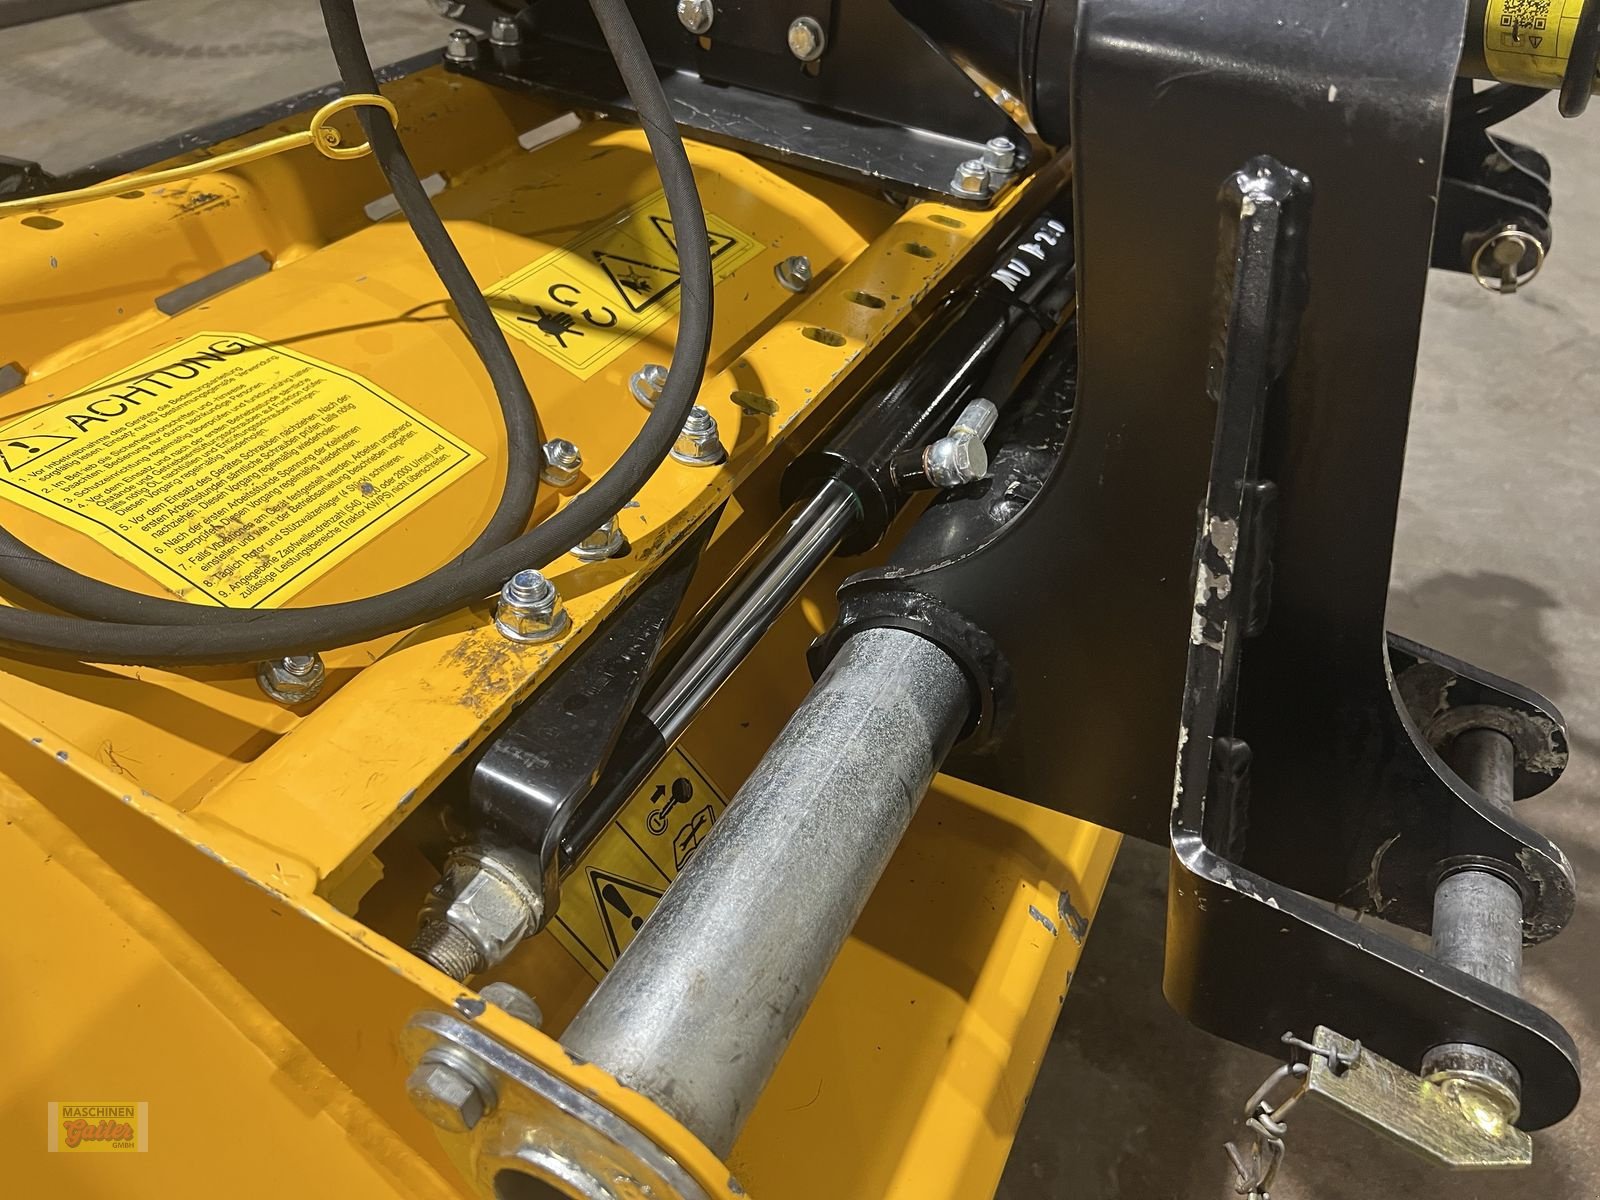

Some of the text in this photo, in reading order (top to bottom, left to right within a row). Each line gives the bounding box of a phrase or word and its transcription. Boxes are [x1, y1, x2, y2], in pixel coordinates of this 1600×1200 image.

[27, 469, 45, 477] Vor
[44, 435, 110, 469] Inbetriebnahme
[110, 427, 127, 435] des
[125, 411, 158, 427] Gerätes
[168, 367, 243, 405] Bedienungsanleitung
[66, 340, 252, 432] ACHTUNG
[97, 456, 112, 464] die
[110, 410, 198, 456] Sicherheitsvorschriften
[197, 401, 213, 410] und
[136, 474, 154, 485] und
[262, 406, 275, 414] auf
[271, 391, 303, 407] Funktion
[39, 460, 81, 481] sorgfältig
[77, 448, 103, 460] lesen.
[103, 431, 135, 447] Einsatz
[134, 423, 148, 431] nur
[73, 456, 151, 497] Schutzeinrichtung
[148, 433, 193, 457] regelmäßig
[190, 411, 232, 433] überprüfen
[230, 402, 246, 411] und
[86, 494, 103, 502] Vor
[104, 483, 124, 494] dem
[122, 465, 155, 483] Einsatz
[154, 456, 171, 466] und
[170, 445, 191, 457] nach
[191, 437, 204, 445] der
[204, 424, 229, 437] ersten
[226, 396, 280, 424] Betriebsstunde
[103, 445, 151, 469] Bedienung
[149, 437, 162, 445] nur
[163, 425, 186, 437] durch
[105, 500, 126, 511] falls
[125, 488, 150, 501] nötig
[161, 457, 202, 480] nachfüllen
[201, 447, 218, 457] und
[215, 405, 293, 448] Entlüftungsschrauben
[115, 429, 269, 516] Diesen Vorgang regelmäßig wiederholen.
[128, 514, 146, 524] Vor
[146, 503, 167, 515] dem
[164, 485, 197, 504] Einsatz
[196, 476, 212, 487] des
[210, 459, 242, 477] Gerätes
[239, 436, 281, 460] Schrauben
[279, 414, 320, 437] nachziehen.
[317, 402, 338, 414] Nach
[141, 514, 169, 531] ersten
[167, 479, 228, 516] Arbeitsstunden
[260, 436, 301, 459] Schrauben
[299, 422, 325, 438] prüfen,
[321, 413, 338, 423] falls
[336, 403, 356, 415] nötig
[151, 425, 340, 539] nachziehen. Diesen Vorgang regelmäßig wiederholen.
[163, 532, 189, 548] Nach
[188, 523, 203, 533] der
[203, 508, 229, 524] ersten
[227, 476, 280, 509] Arbeitsstunde
[277, 454, 317, 477] Spannung
[314, 446, 326, 456] der
[188, 549, 212, 565] Falls
[265, 499, 289, 515] Gerät
[286, 475, 327, 502] festgestellt
[325, 460, 355, 477] werden,
[351, 442, 380, 461] Arbeiten
[379, 420, 412, 443] umgehend
[220, 507, 250, 526] Diesen
[246, 488, 282, 508] Vorgang
[279, 464, 320, 490] regelmäßig
[317, 440, 360, 465] wiederholen.
[201, 546, 240, 571] einstellen
[238, 533, 256, 547] und
[252, 526, 270, 536] wie
[275, 511, 290, 521] der
[287, 473, 351, 513] Betriebsanleitung
[346, 449, 388, 475] beschrieben
[386, 431, 418, 450] vorgehen.
[210, 560, 245, 581] Täglich
[241, 544, 266, 561] Rotor
[265, 533, 283, 546] und
[280, 495, 340, 536] Stützwalzenlager
[369, 455, 405, 478] schmieren.
[229, 555, 279, 592] Angegebene
[276, 510, 347, 558] Zapfwellendrehzahl
[380, 477, 396, 489] oder
[393, 465, 412, 479] 2000
[431, 444, 445, 454] und
[239, 450, 448, 599] zulässige Leistungsbereiche (Traktor KW/PS) nicht überschreiten.
